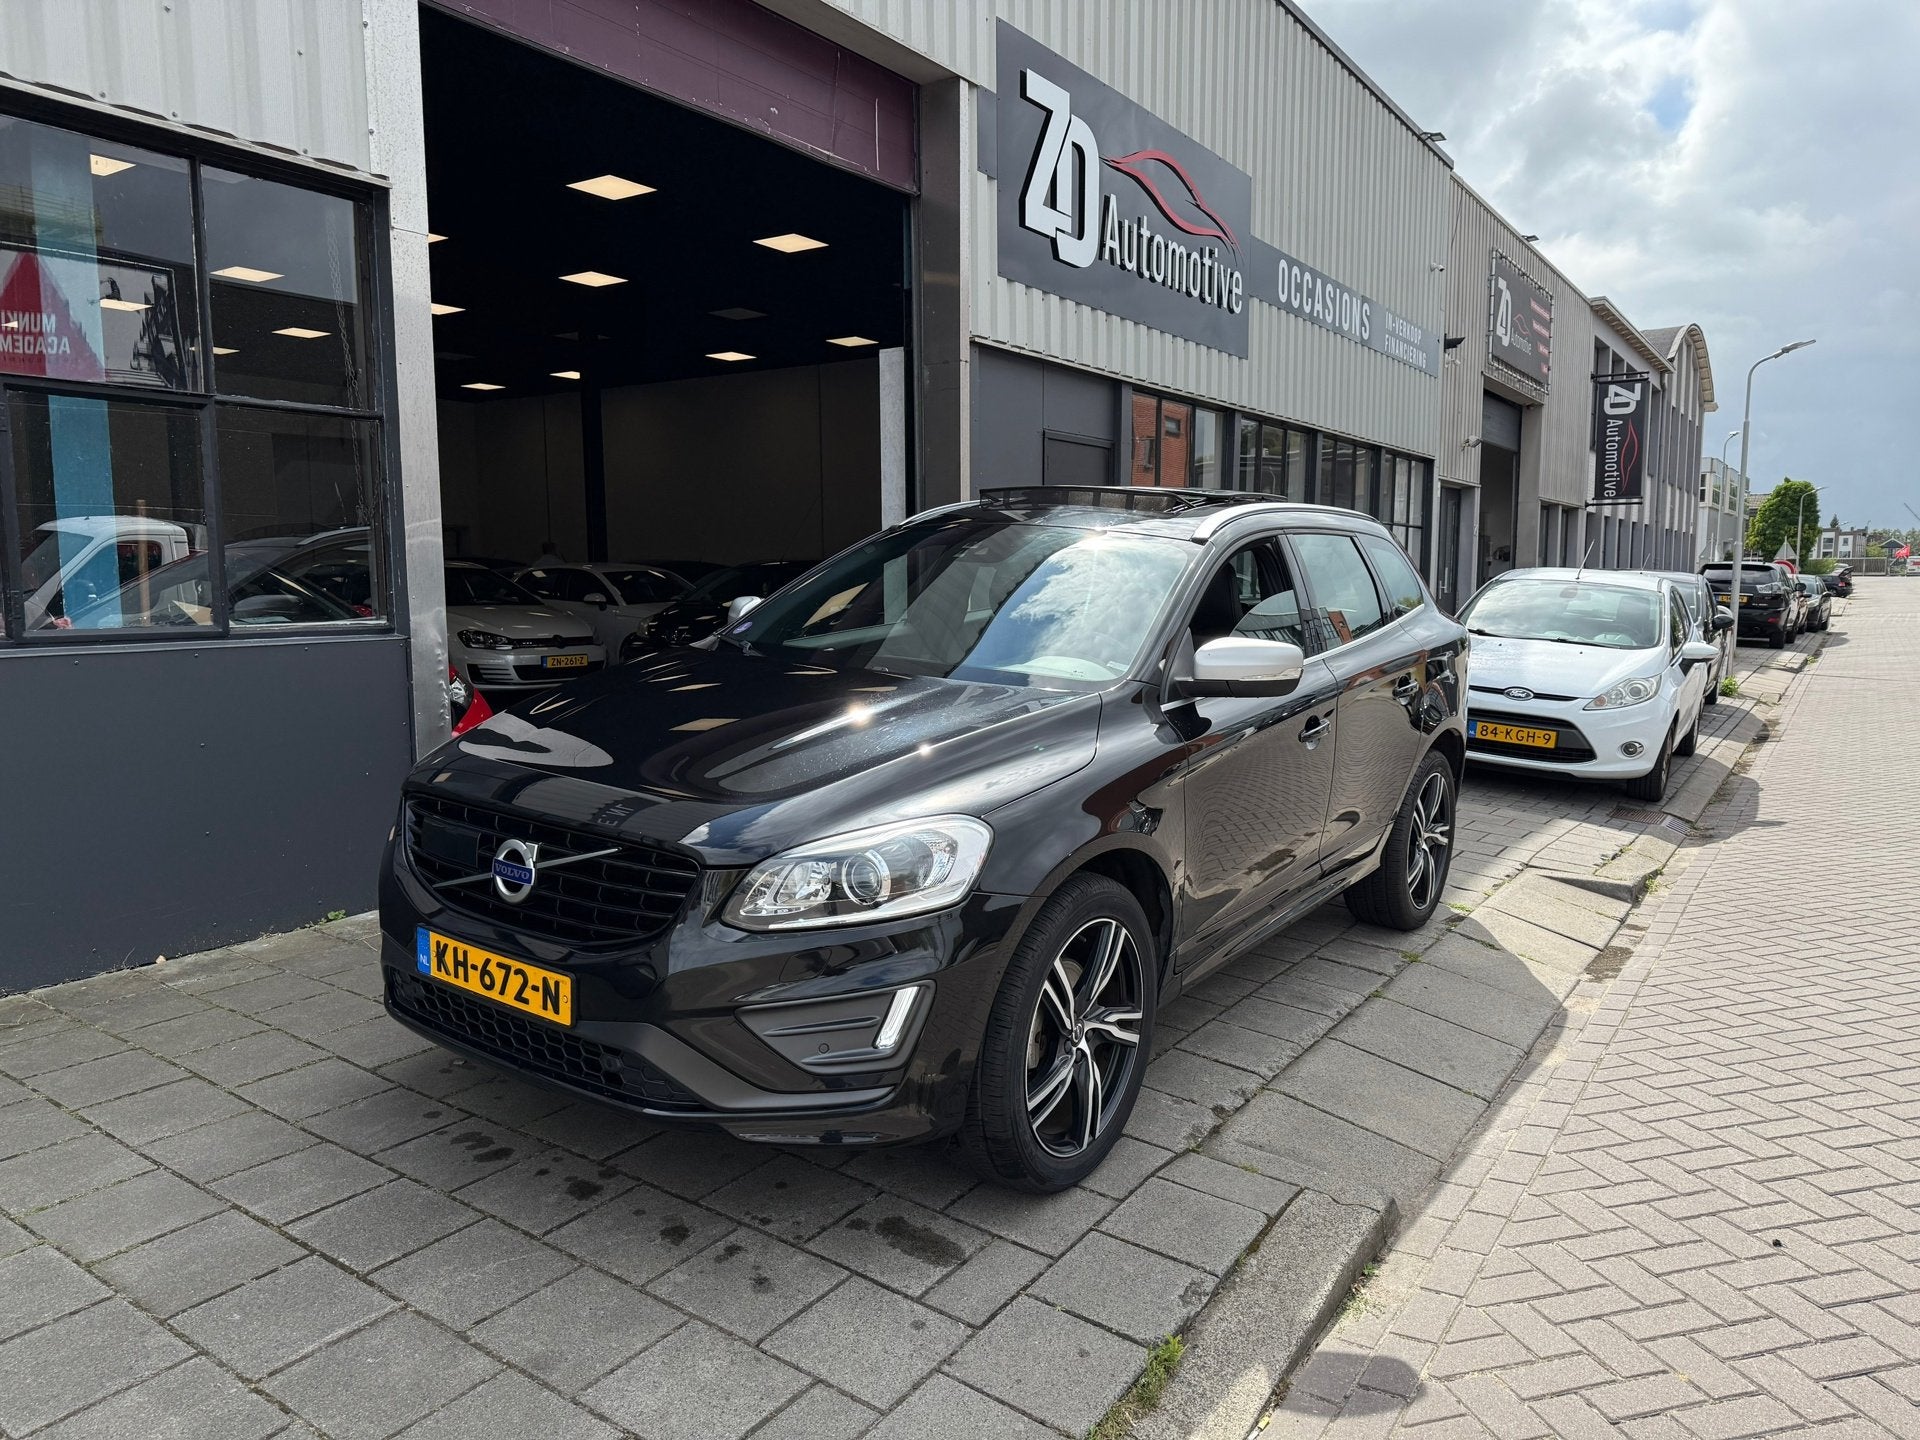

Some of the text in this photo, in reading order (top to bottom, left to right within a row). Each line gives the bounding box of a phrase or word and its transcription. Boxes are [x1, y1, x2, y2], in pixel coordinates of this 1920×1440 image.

[1102, 193, 1243, 314] Automotive
[1278, 259, 1370, 340] OCCASIONS
[1384, 334, 1427, 369] FINANCIERING
[1603, 419, 1624, 497] Automotive
[1480, 724, 1552, 745] 84-KGH-9
[494, 862, 530, 880] VOLVO
[419, 939, 560, 1015] NL KH-672-N
